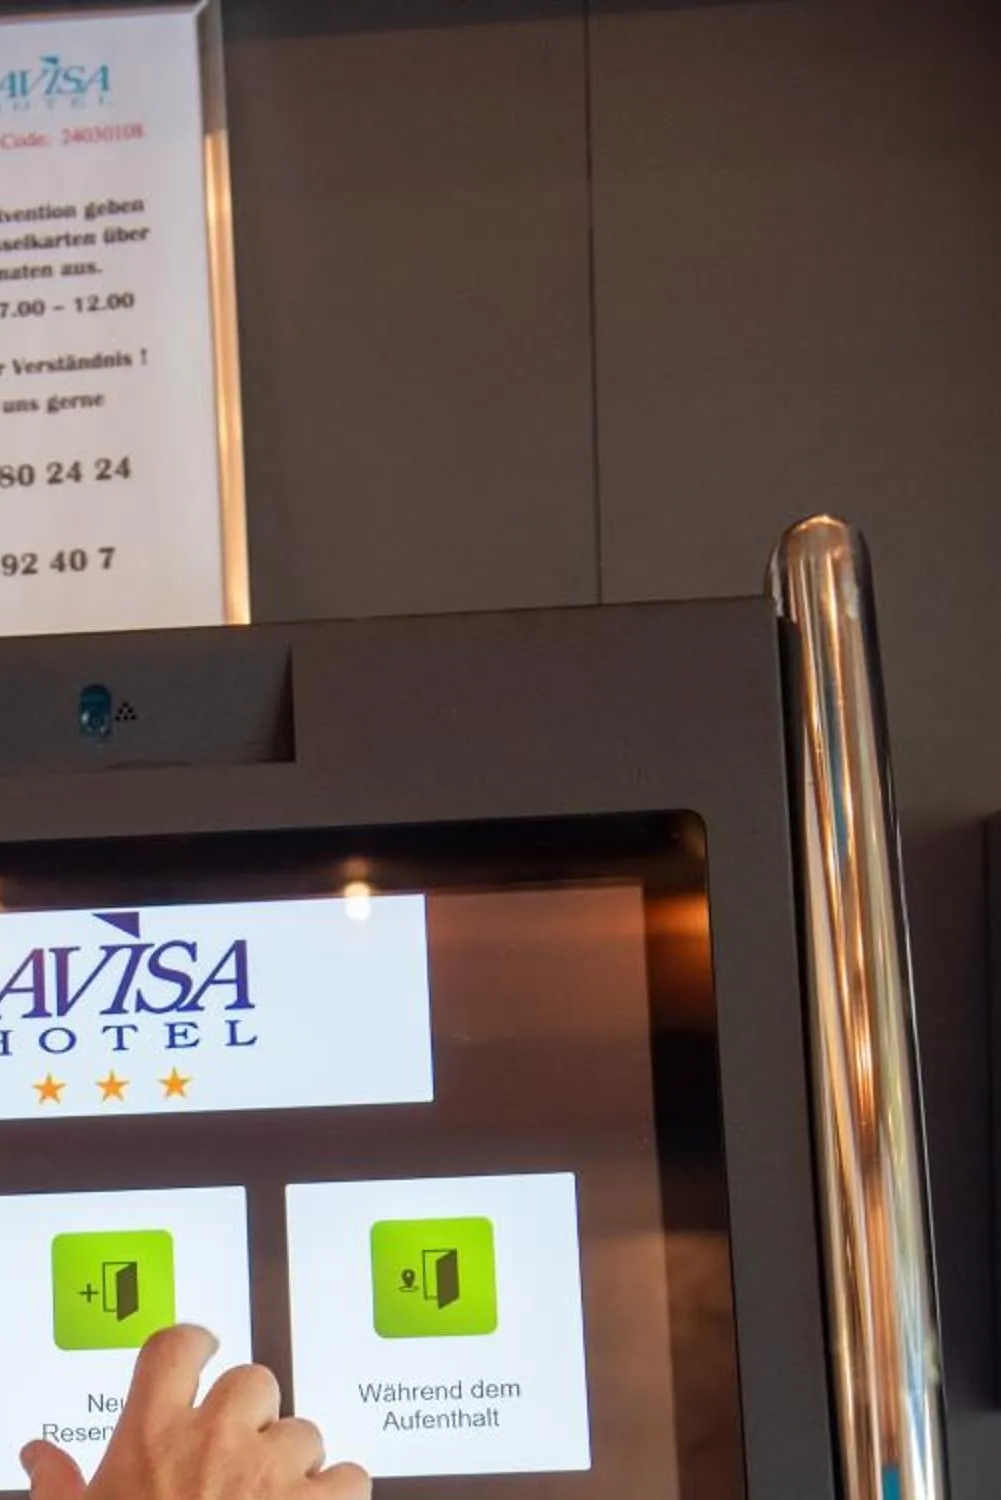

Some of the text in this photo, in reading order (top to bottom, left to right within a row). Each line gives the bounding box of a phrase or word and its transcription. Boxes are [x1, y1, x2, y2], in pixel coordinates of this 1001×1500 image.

[84, 198, 145, 221] geben
[103, 226, 151, 246] über
[61, 260, 103, 277] aus.
[74, 292, 135, 314] 12.00
[12, 351, 133, 375] Verständnis
[140, 347, 148, 366] !
[2, 398, 40, 414] uns
[46, 393, 105, 414] gerne
[46, 459, 83, 484] 24
[94, 456, 132, 482] 24
[1, 552, 39, 577] 92
[49, 548, 88, 573] 40
[98, 546, 117, 570] 7
[358, 1378, 521, 1403] Während dem
[382, 1407, 501, 1432] Aufenthalt
